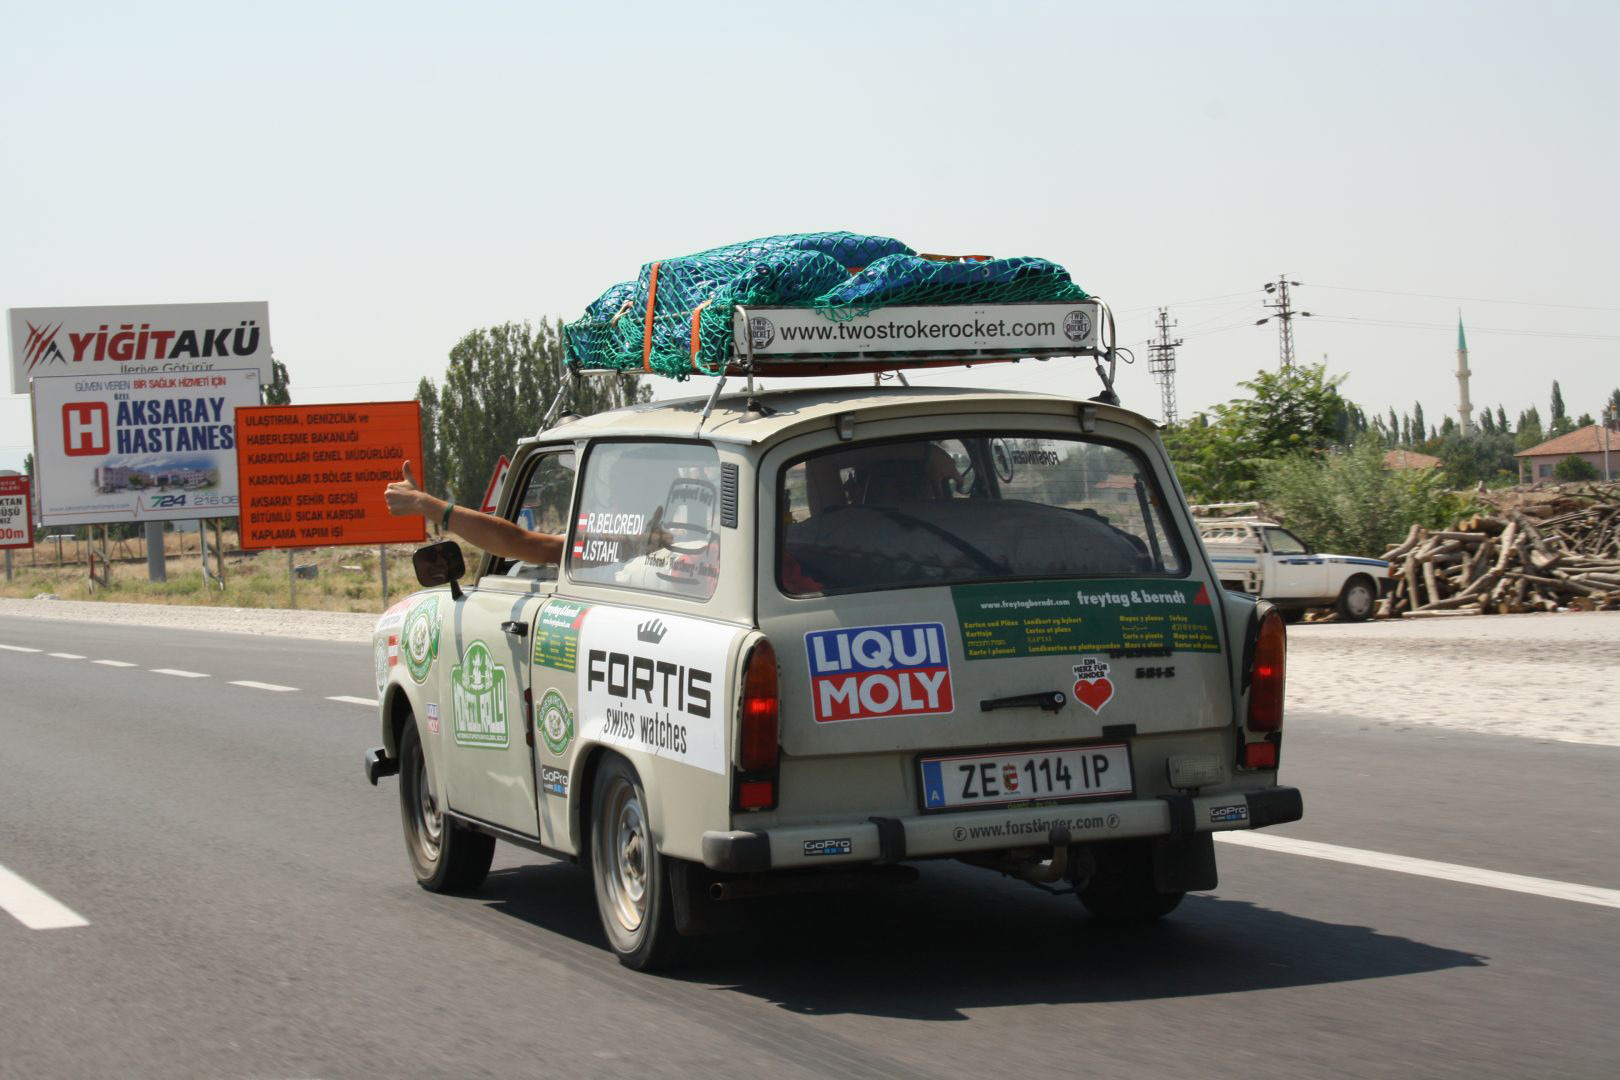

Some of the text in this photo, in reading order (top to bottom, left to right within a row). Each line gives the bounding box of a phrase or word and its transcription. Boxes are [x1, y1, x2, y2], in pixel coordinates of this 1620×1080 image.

[780, 319, 1056, 341] www.twostrokerocket.com
[104, 380, 130, 390] VEREN
[116, 397, 225, 426] AKSARAY
[116, 424, 237, 454] HASTANES
[248, 451, 310, 464] KARAYOLLARI
[313, 450, 342, 461] GENEL
[249, 473, 312, 486] KARAYOLLARI
[251, 495, 293, 508] AKSARAY
[587, 513, 645, 535] R.BELCREDI
[252, 528, 296, 540] KAPLAMA
[301, 527, 328, 538] YAPIM
[582, 541, 620, 562] J.STAHL
[813, 627, 941, 672] LIQUI
[1074, 662, 1108, 673] HERZ FÜR
[1078, 671, 1105, 679] KINDER
[588, 649, 713, 719] FORTIS
[818, 669, 944, 717] MOLY
[605, 702, 635, 740] swiss
[641, 709, 688, 755] watches
[542, 768, 569, 785] GoPro
[959, 754, 1110, 799] ZE 114 IP
[931, 790, 940, 801] A
[1211, 806, 1246, 816] GoPro
[804, 840, 850, 849] GoPro
